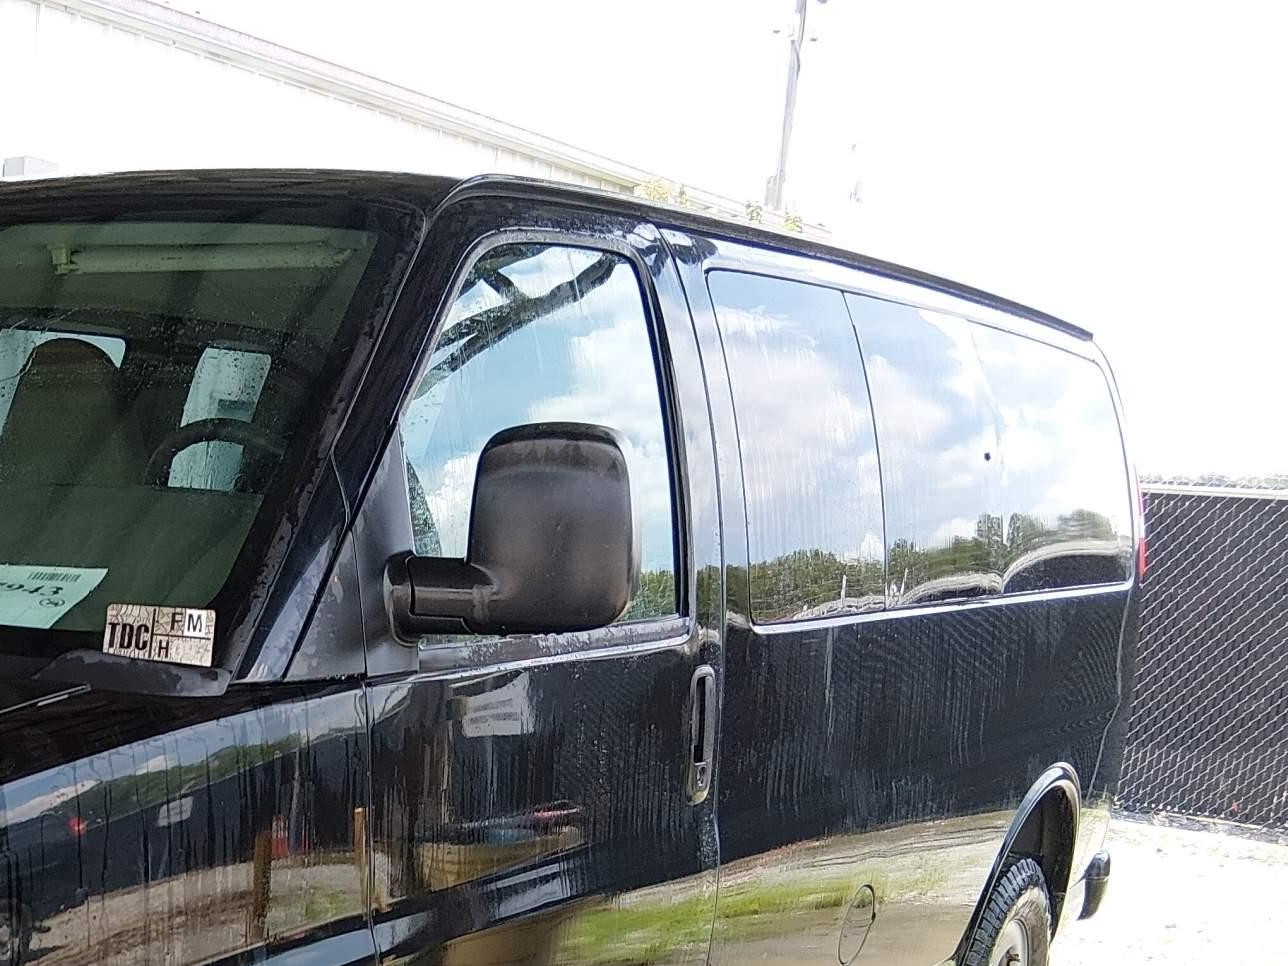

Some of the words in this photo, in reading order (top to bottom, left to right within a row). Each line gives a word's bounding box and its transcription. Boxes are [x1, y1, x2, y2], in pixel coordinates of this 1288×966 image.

[187, 613, 202, 633] M
[108, 622, 150, 651] TDC
[158, 639, 170, 658] H
